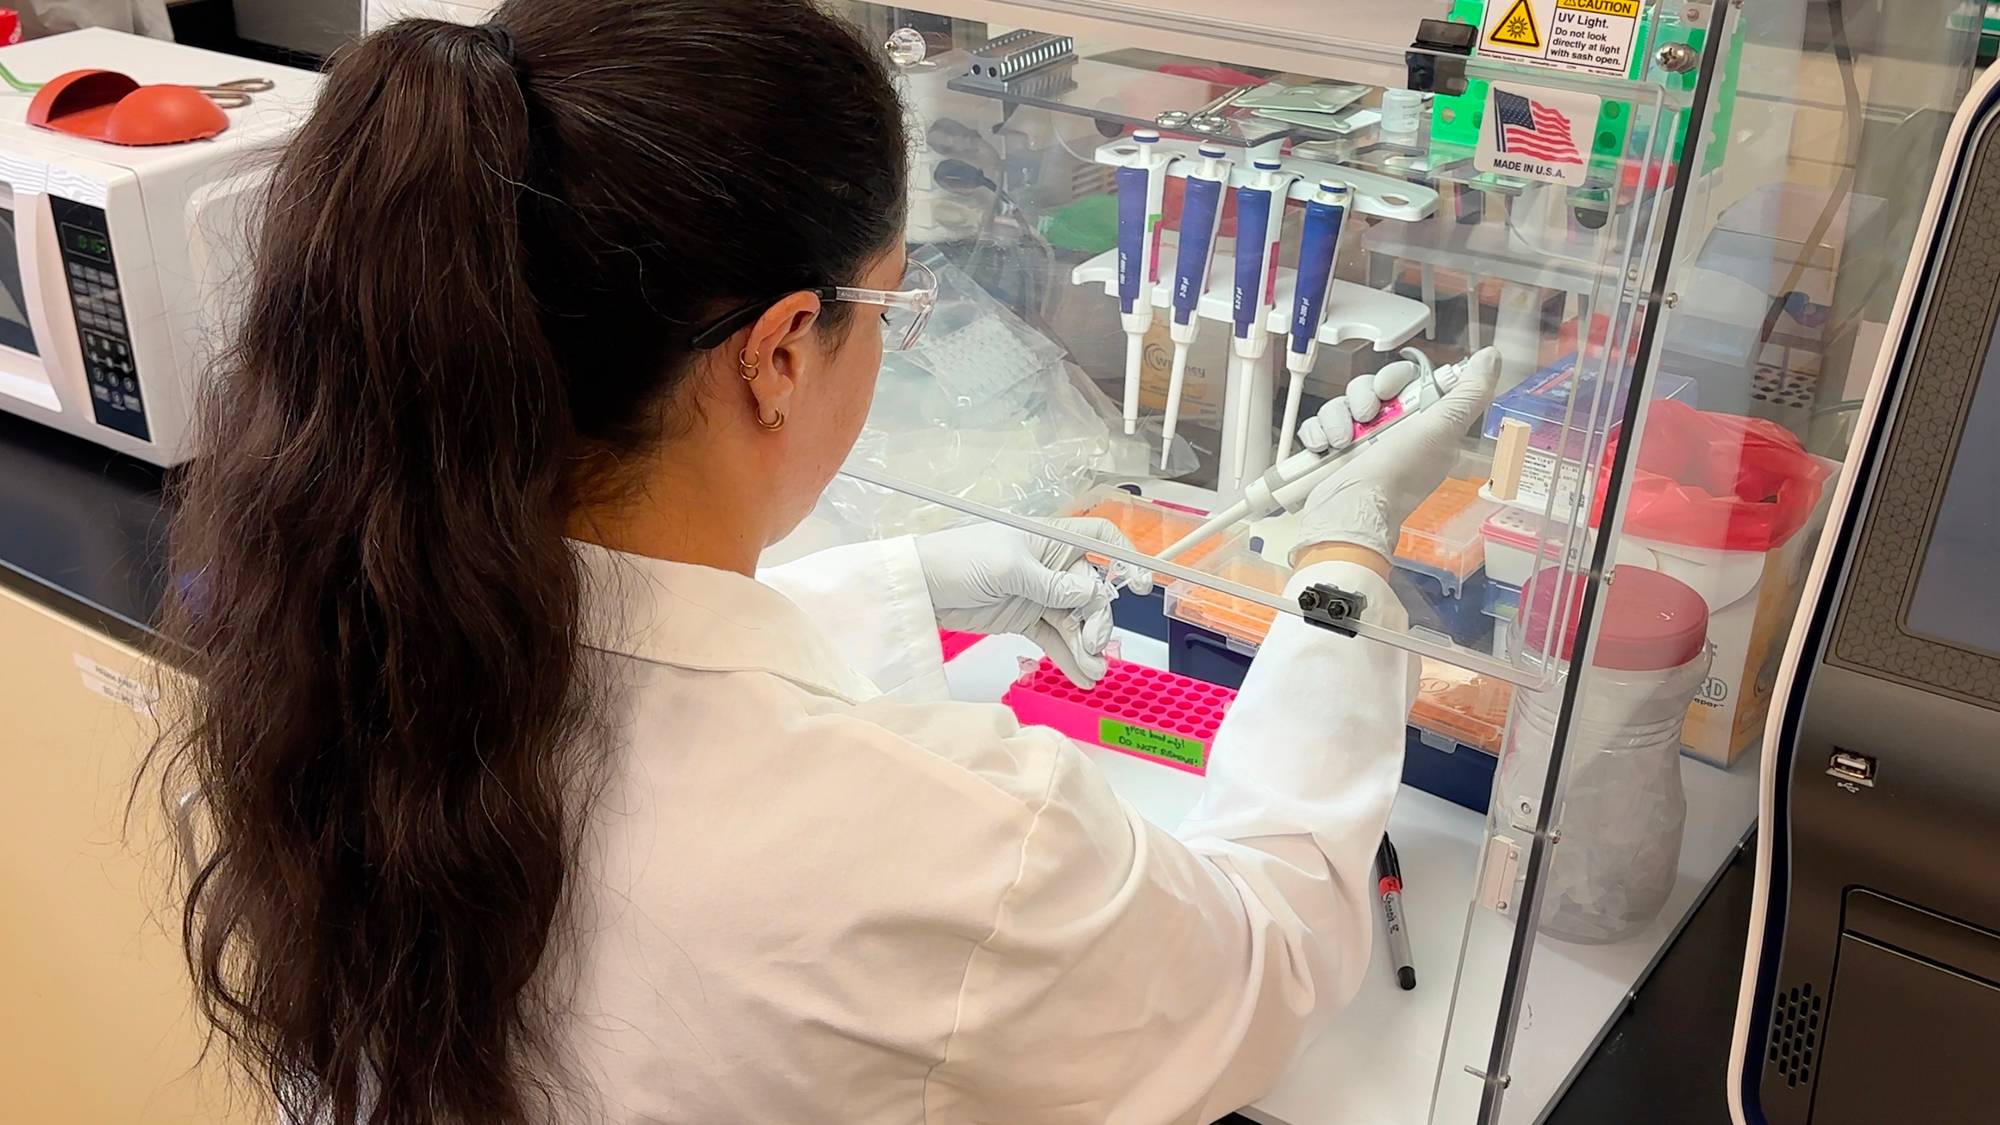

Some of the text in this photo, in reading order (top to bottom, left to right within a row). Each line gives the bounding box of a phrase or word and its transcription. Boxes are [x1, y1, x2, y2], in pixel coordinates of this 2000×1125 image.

[1578, 0, 1632, 14] CAUTION
[1558, 12, 1609, 29] UV Light.
[1555, 27, 1607, 42] Do not look
[1552, 38, 1621, 55] directly at light
[1550, 48, 1622, 66] with sash open.
[1493, 158, 1566, 179] MADE IN U.S.A.
